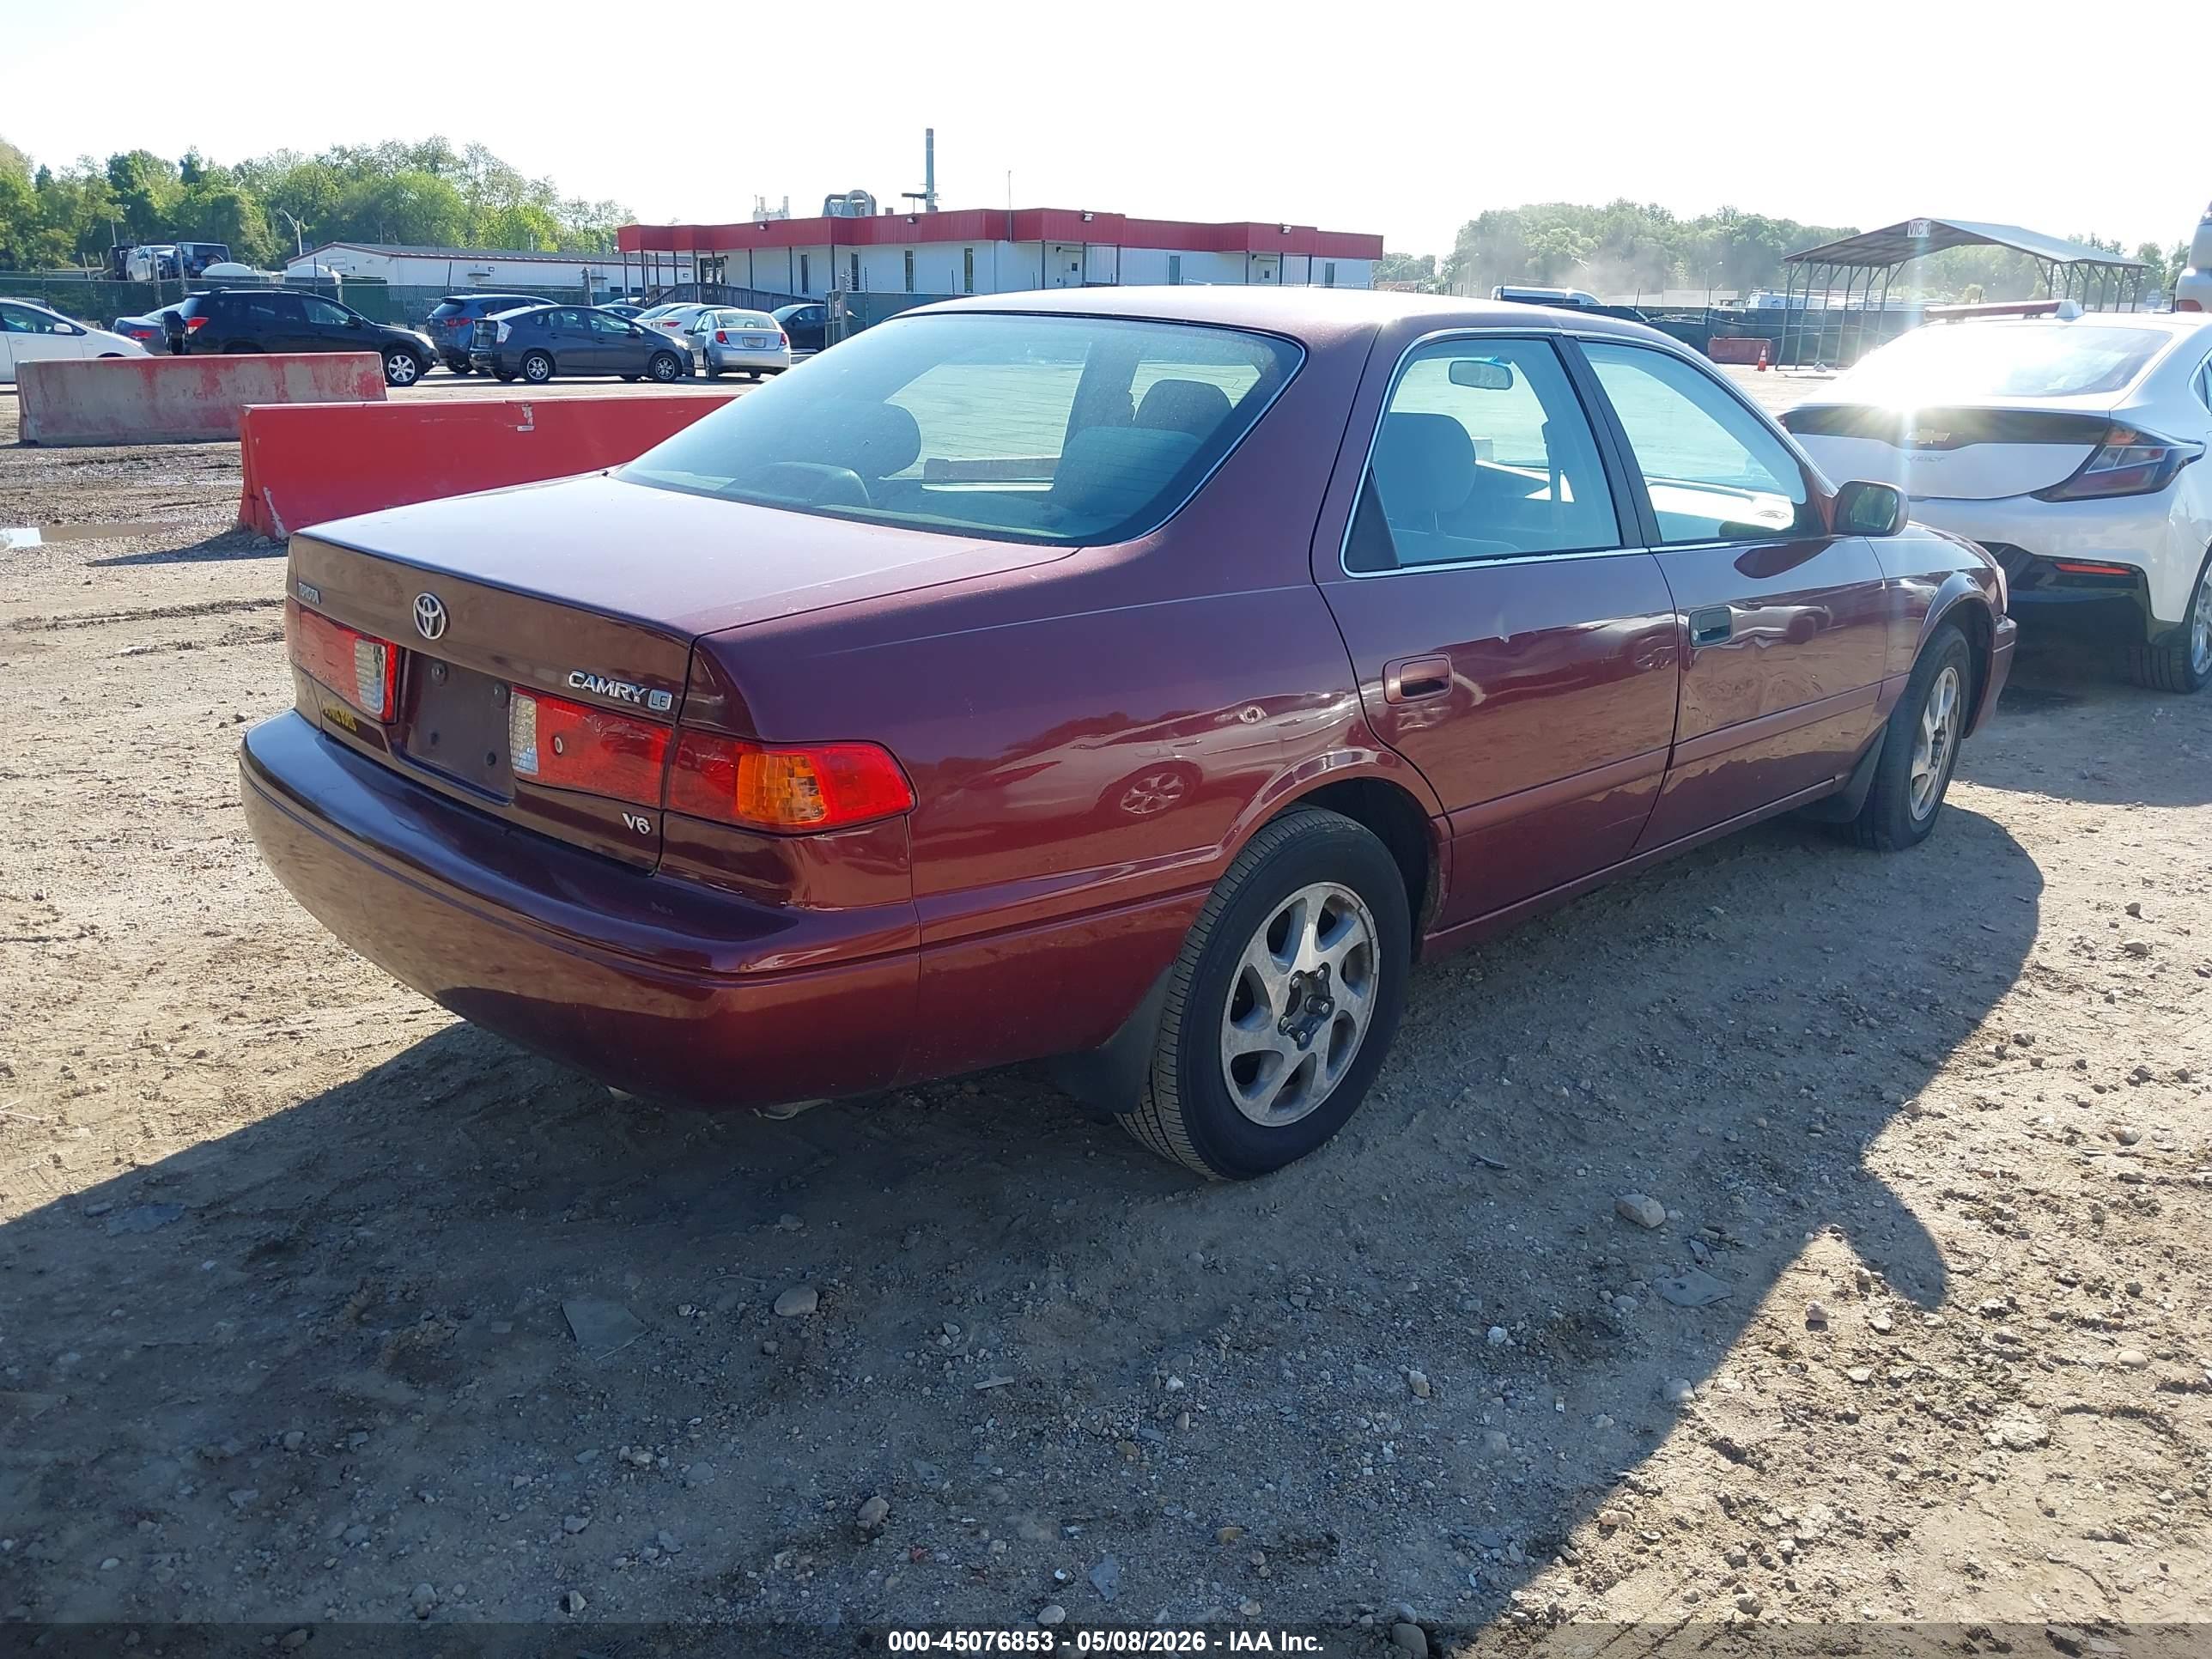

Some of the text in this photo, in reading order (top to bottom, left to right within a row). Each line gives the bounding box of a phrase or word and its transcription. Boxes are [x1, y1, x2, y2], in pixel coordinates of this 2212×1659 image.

[1908, 222, 1923, 236] VIC
[568, 670, 669, 709] CAMRY LE
[621, 812, 651, 835] V6
